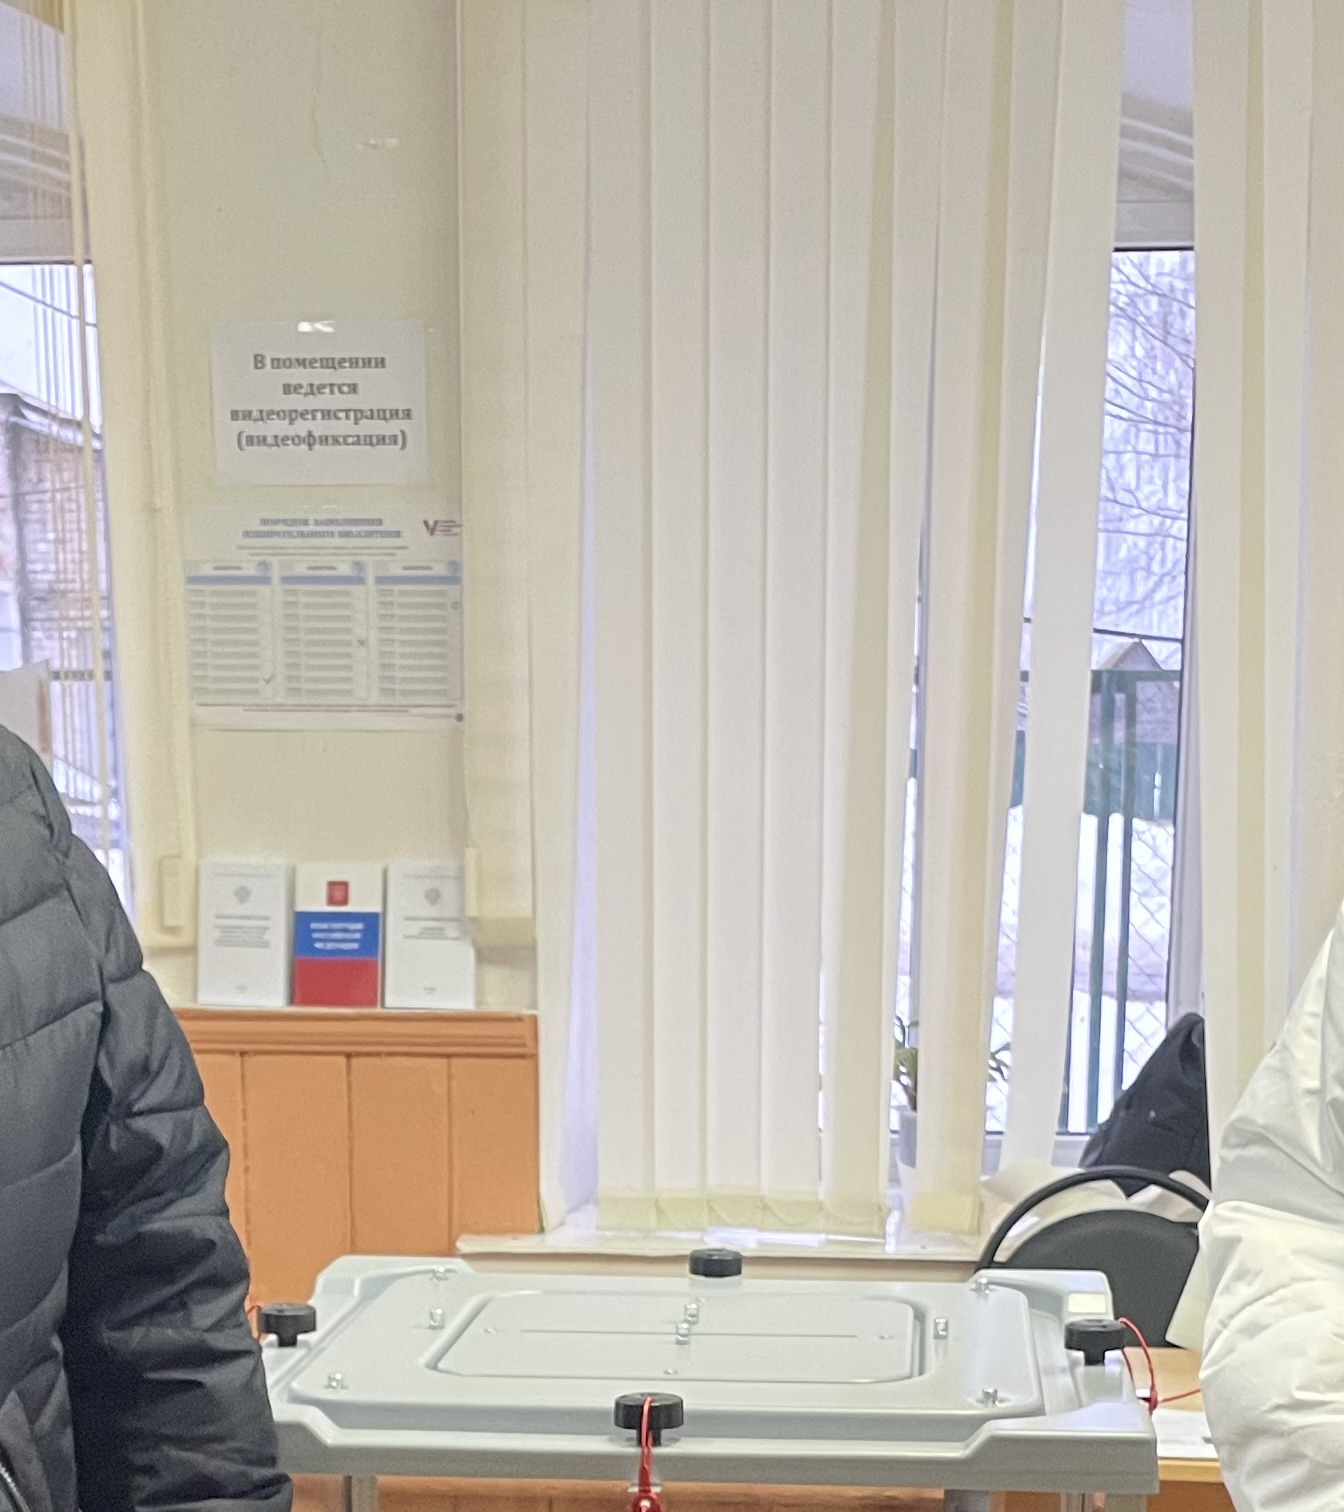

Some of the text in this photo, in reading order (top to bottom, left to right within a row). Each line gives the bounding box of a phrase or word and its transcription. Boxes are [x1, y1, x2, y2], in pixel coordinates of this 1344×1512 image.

[253, 354, 387, 371] В помещении
[282, 383, 359, 397] ведется
[230, 408, 413, 425] видеорегистрация
[237, 429, 407, 451] (видеофиксация)
